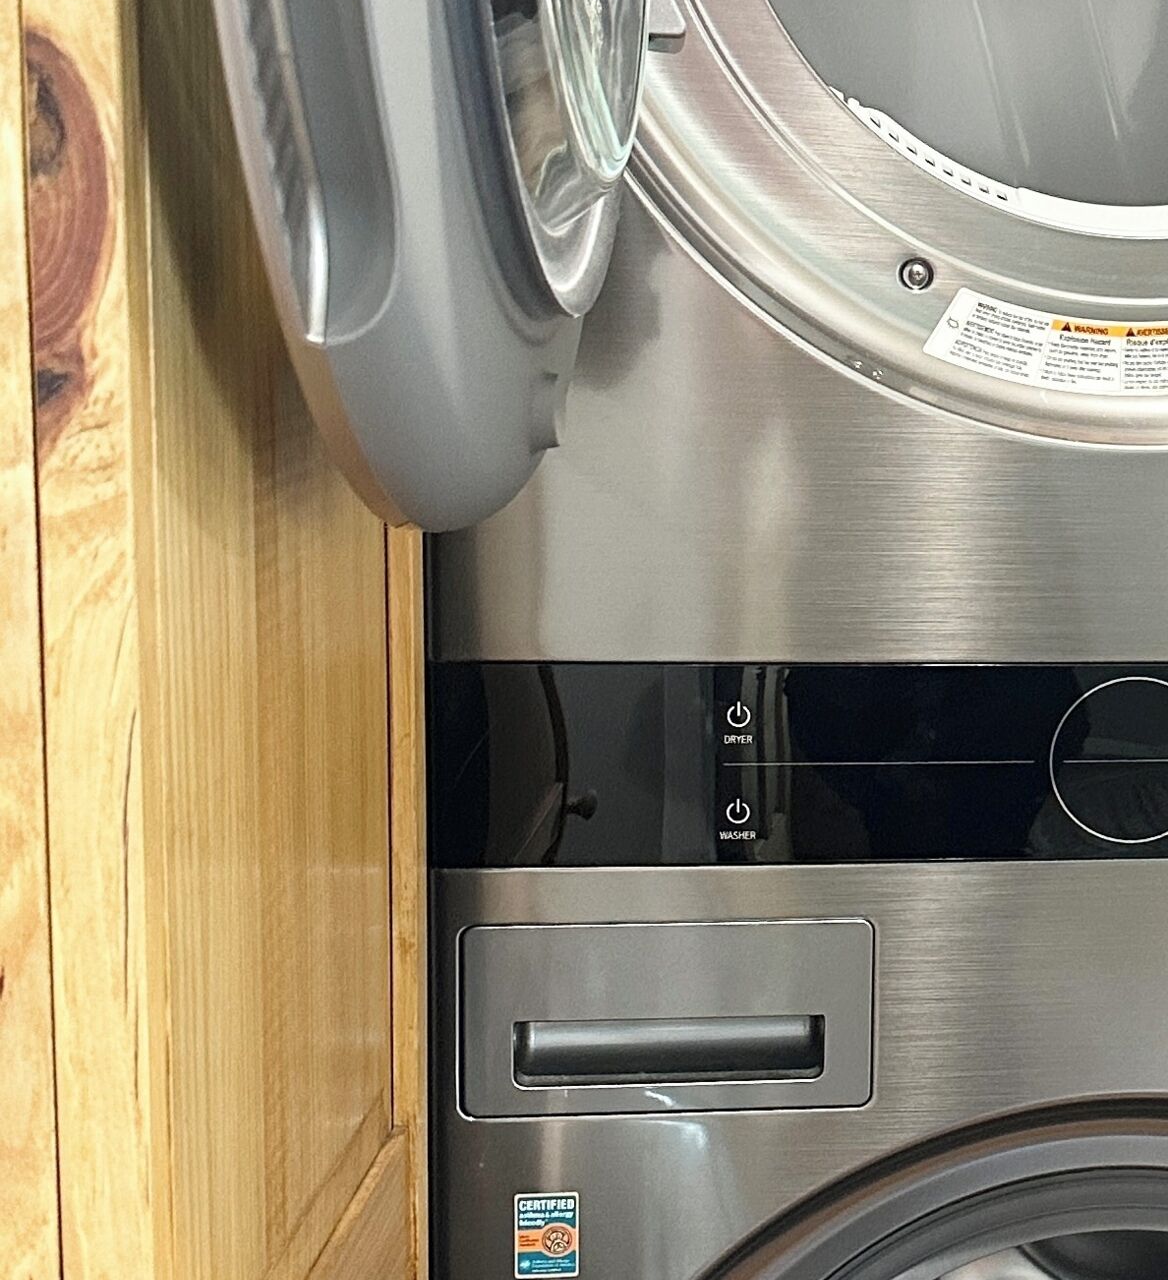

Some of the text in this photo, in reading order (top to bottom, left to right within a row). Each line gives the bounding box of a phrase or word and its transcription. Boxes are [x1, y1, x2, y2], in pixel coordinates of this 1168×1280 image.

[1074, 325, 1109, 336] WARNING
[723, 735, 753, 745] DRYER
[719, 831, 756, 840] WASHER
[519, 1199, 575, 1211] CERTIFIED
